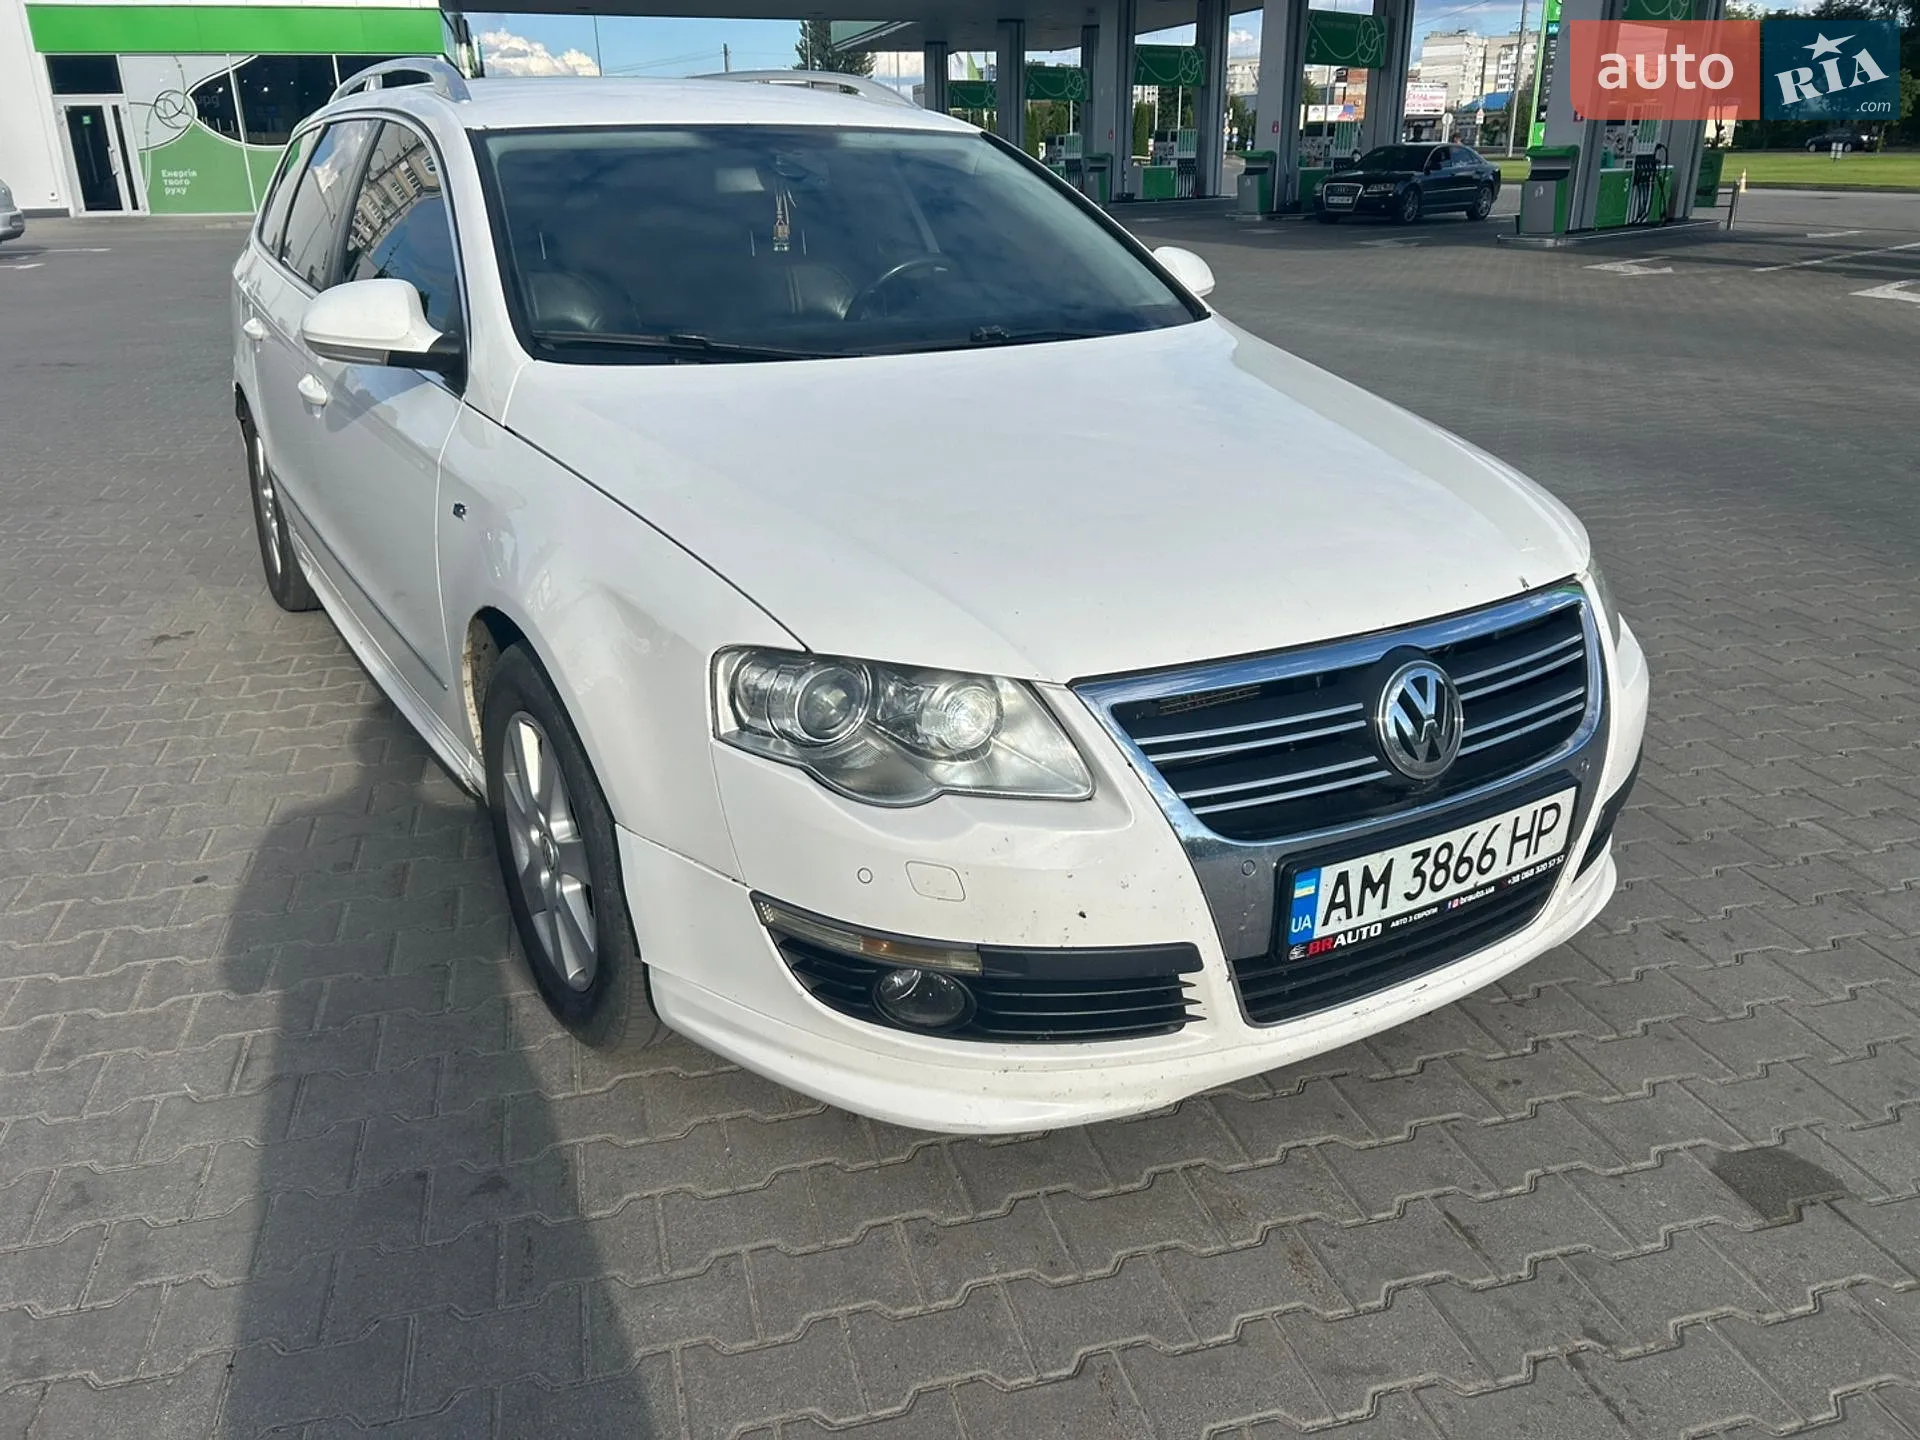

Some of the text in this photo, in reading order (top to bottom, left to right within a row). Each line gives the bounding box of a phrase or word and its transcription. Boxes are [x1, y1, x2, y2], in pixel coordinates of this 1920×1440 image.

[161, 169, 197, 178] Енергія
[164, 186, 187, 196] руху
[1322, 802, 1562, 927] AM 3866 HP
[1291, 915, 1312, 933] UA
